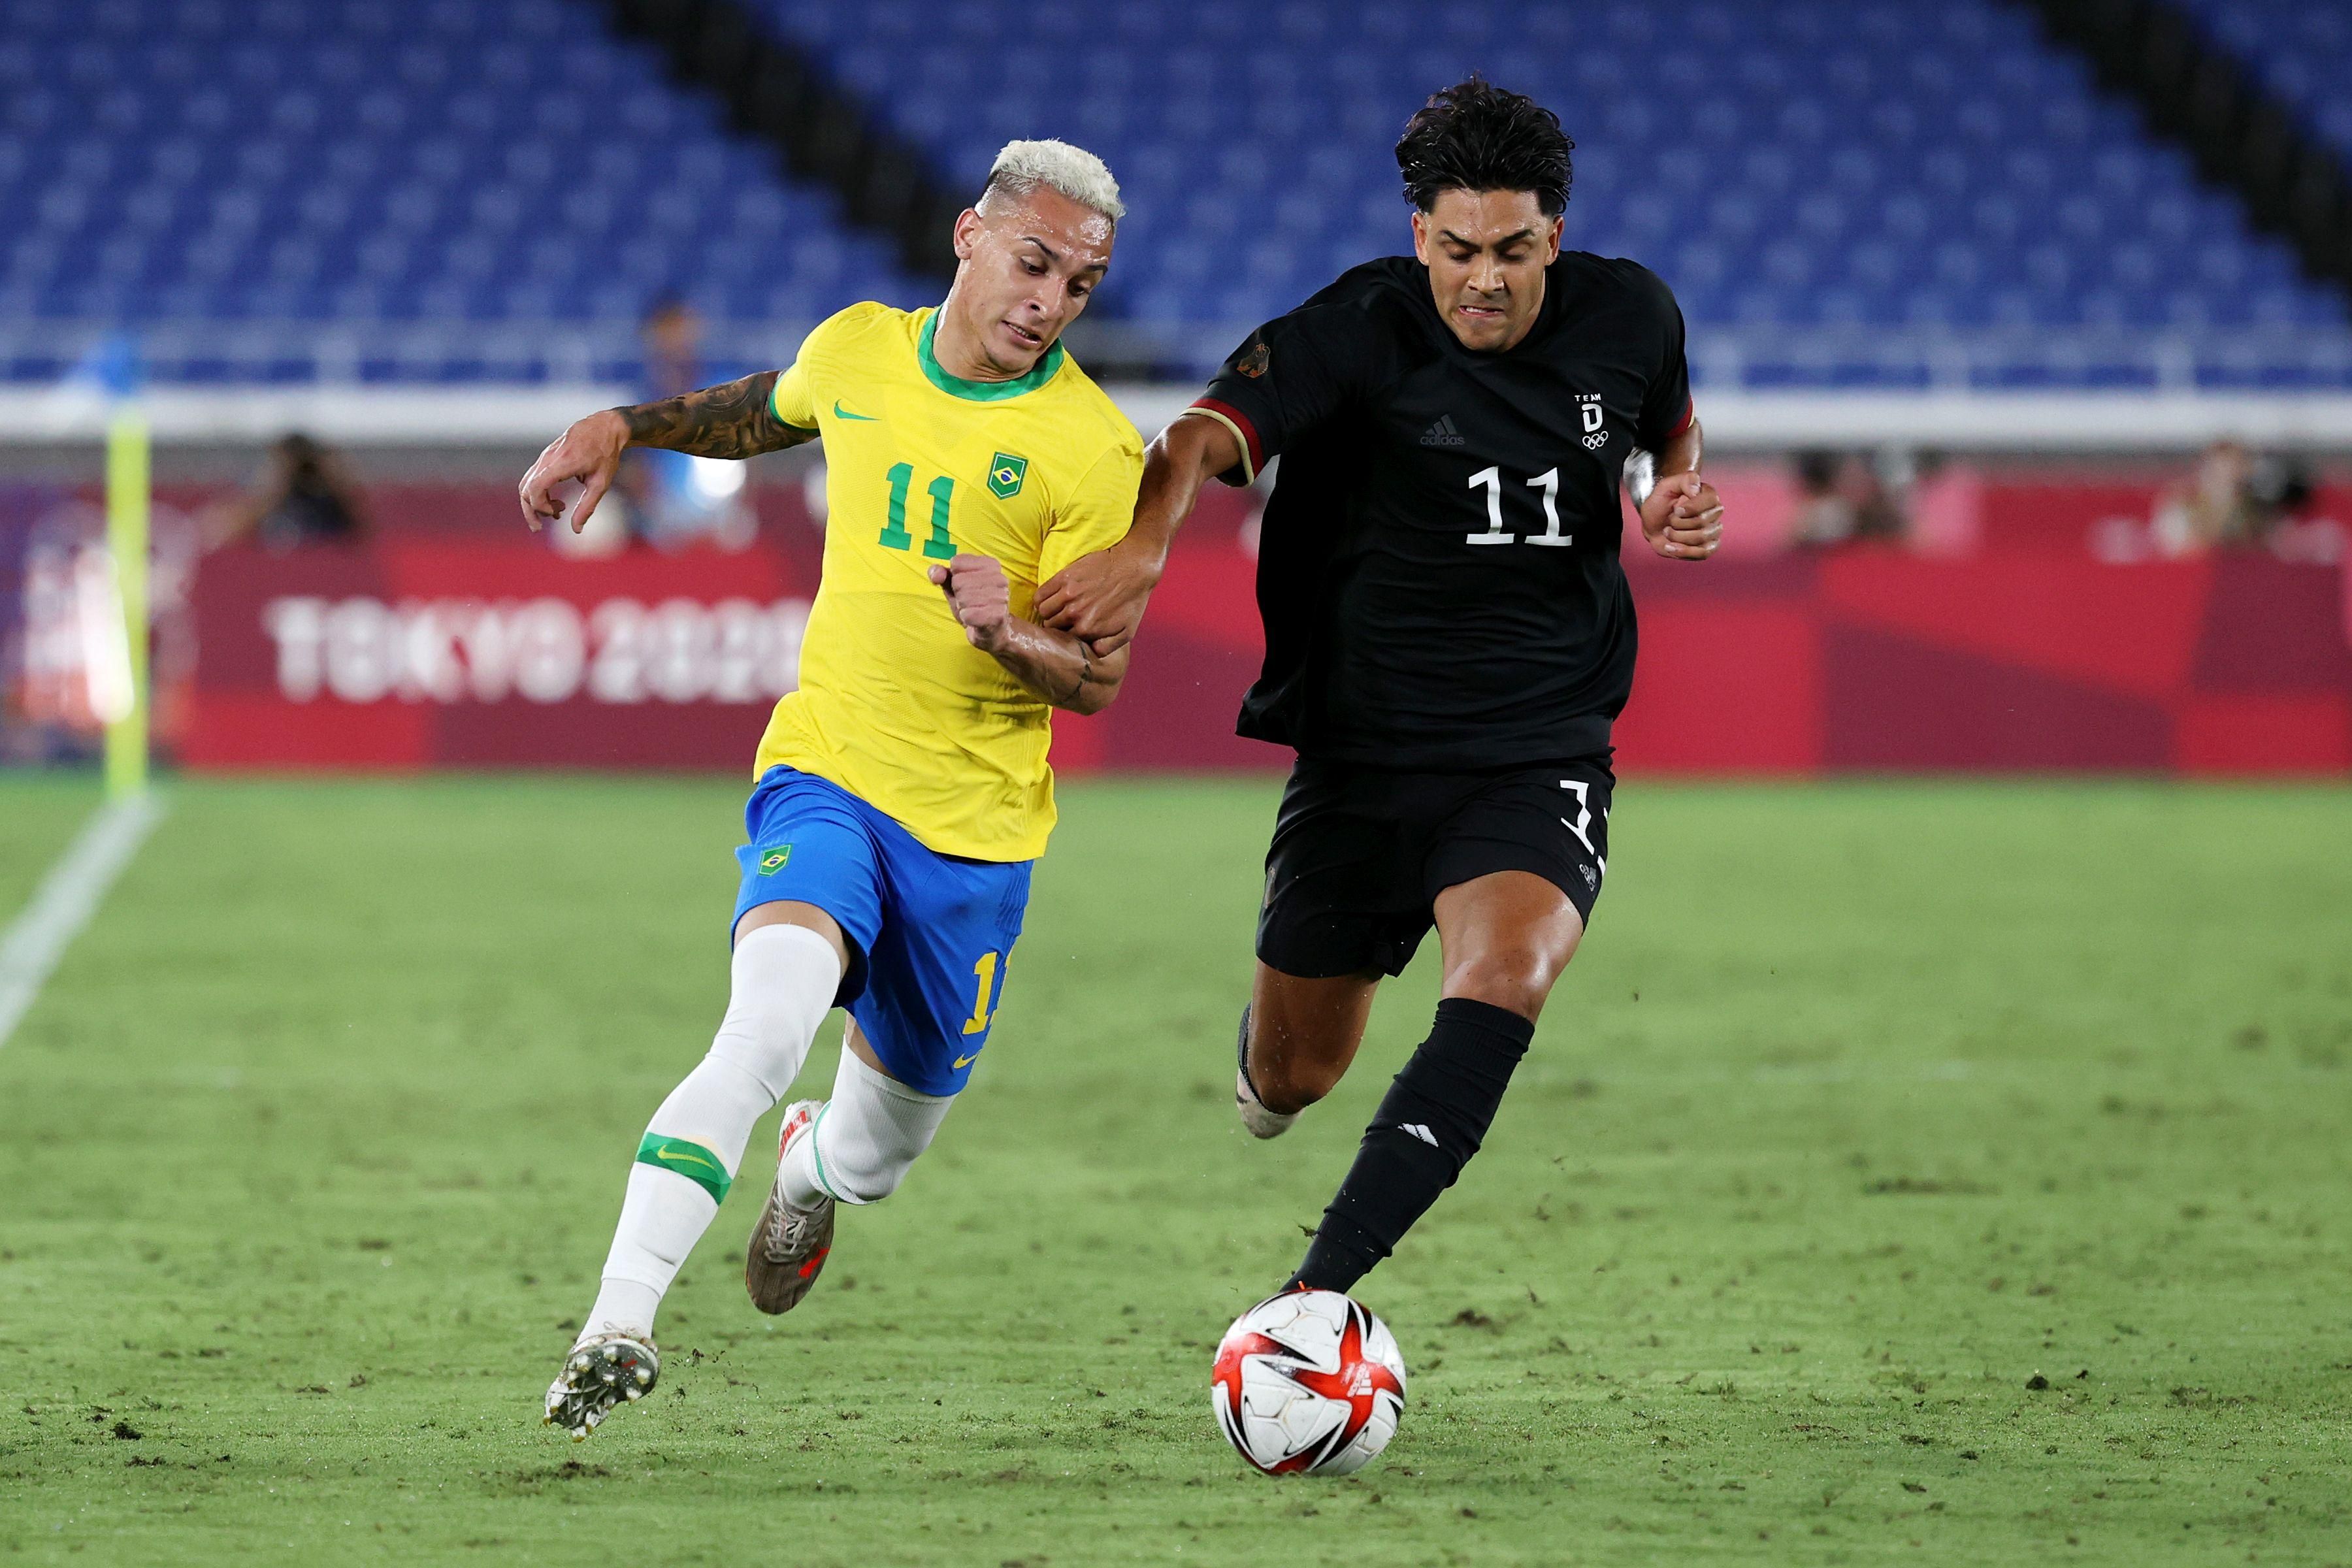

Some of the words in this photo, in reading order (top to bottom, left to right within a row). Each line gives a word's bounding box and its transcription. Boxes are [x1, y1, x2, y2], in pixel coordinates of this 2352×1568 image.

[1574, 393, 1601, 402] TEAM
[1420, 434, 1465, 446] adidas
[878, 462, 958, 561] 11
[1466, 465, 1573, 546] 11
[269, 596, 584, 705] TOKYO
[962, 951, 1011, 1035] 1
